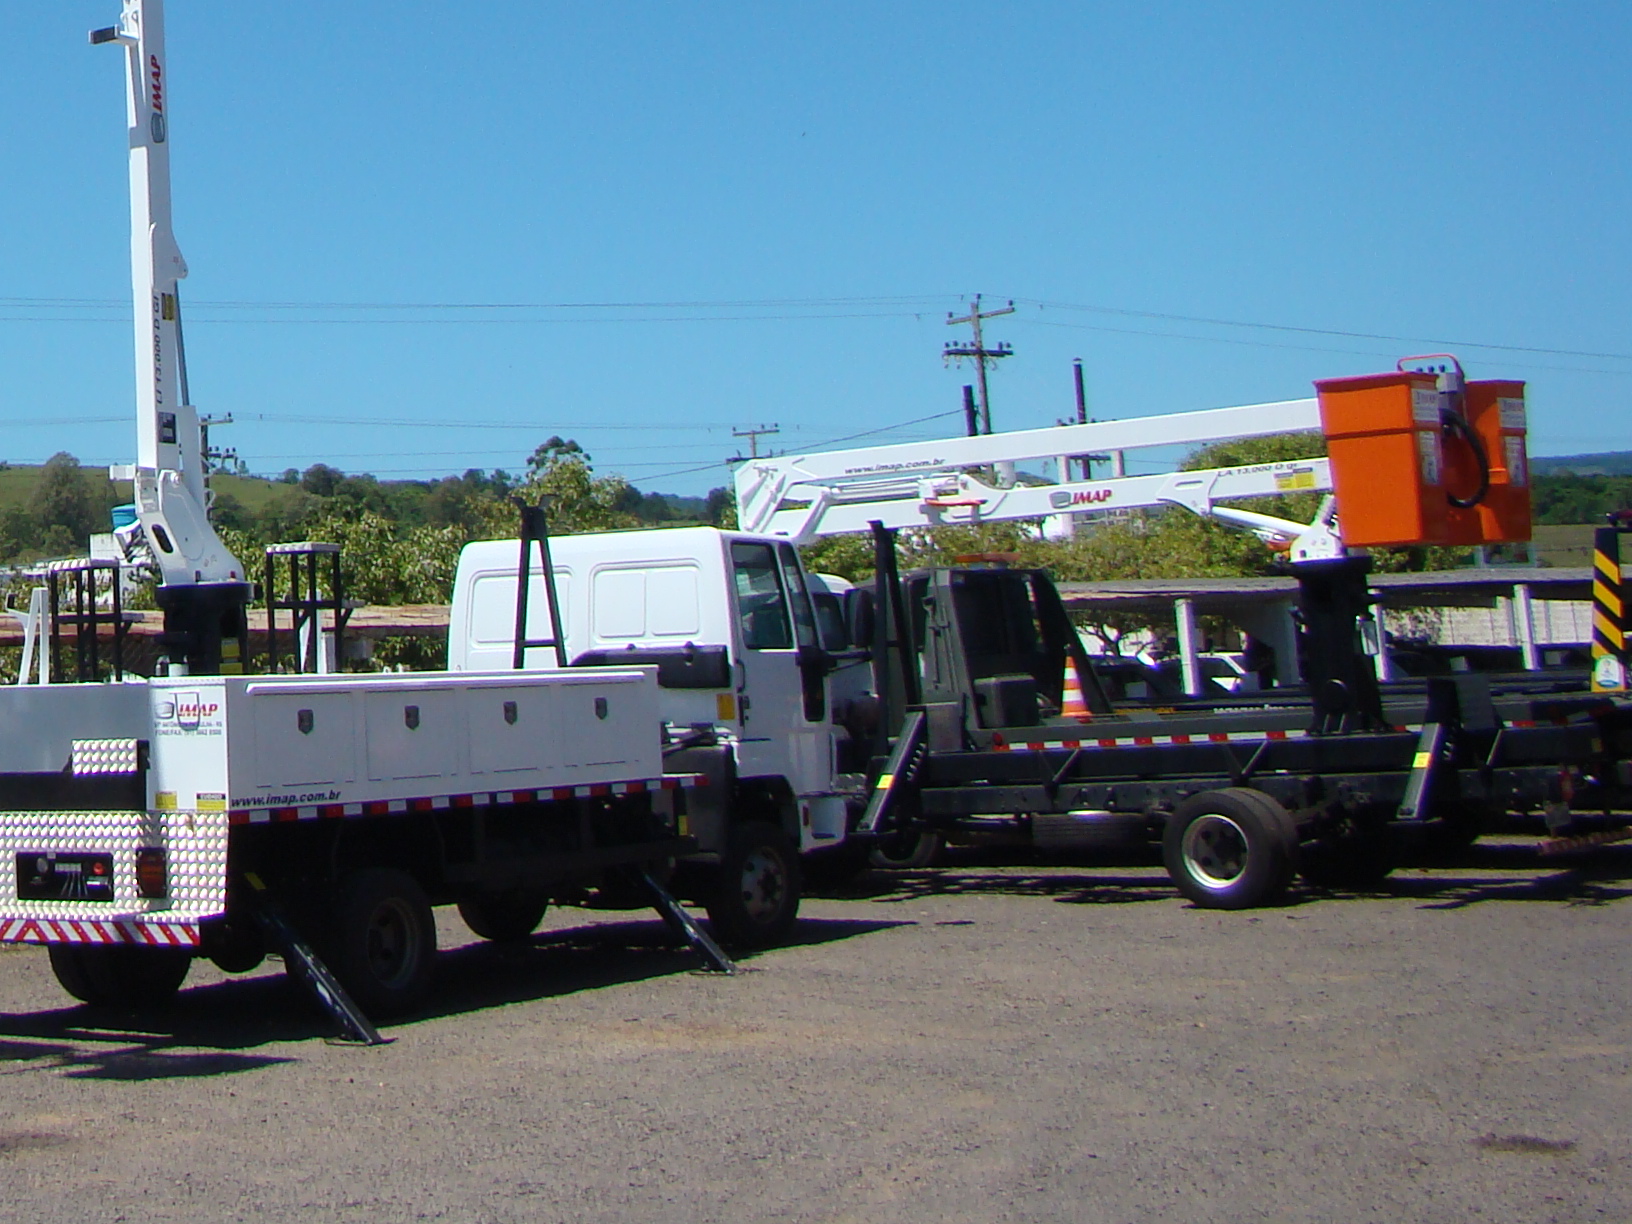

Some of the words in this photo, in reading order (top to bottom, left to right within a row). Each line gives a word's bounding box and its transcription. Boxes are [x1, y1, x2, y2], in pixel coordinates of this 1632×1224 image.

[151, 54, 164, 114] IMAP
[844, 457, 946, 475] www.imap.com.br
[1070, 488, 1112, 505] IMAP
[178, 703, 219, 717] IMAP
[231, 789, 341, 807] www.imap.com.br
